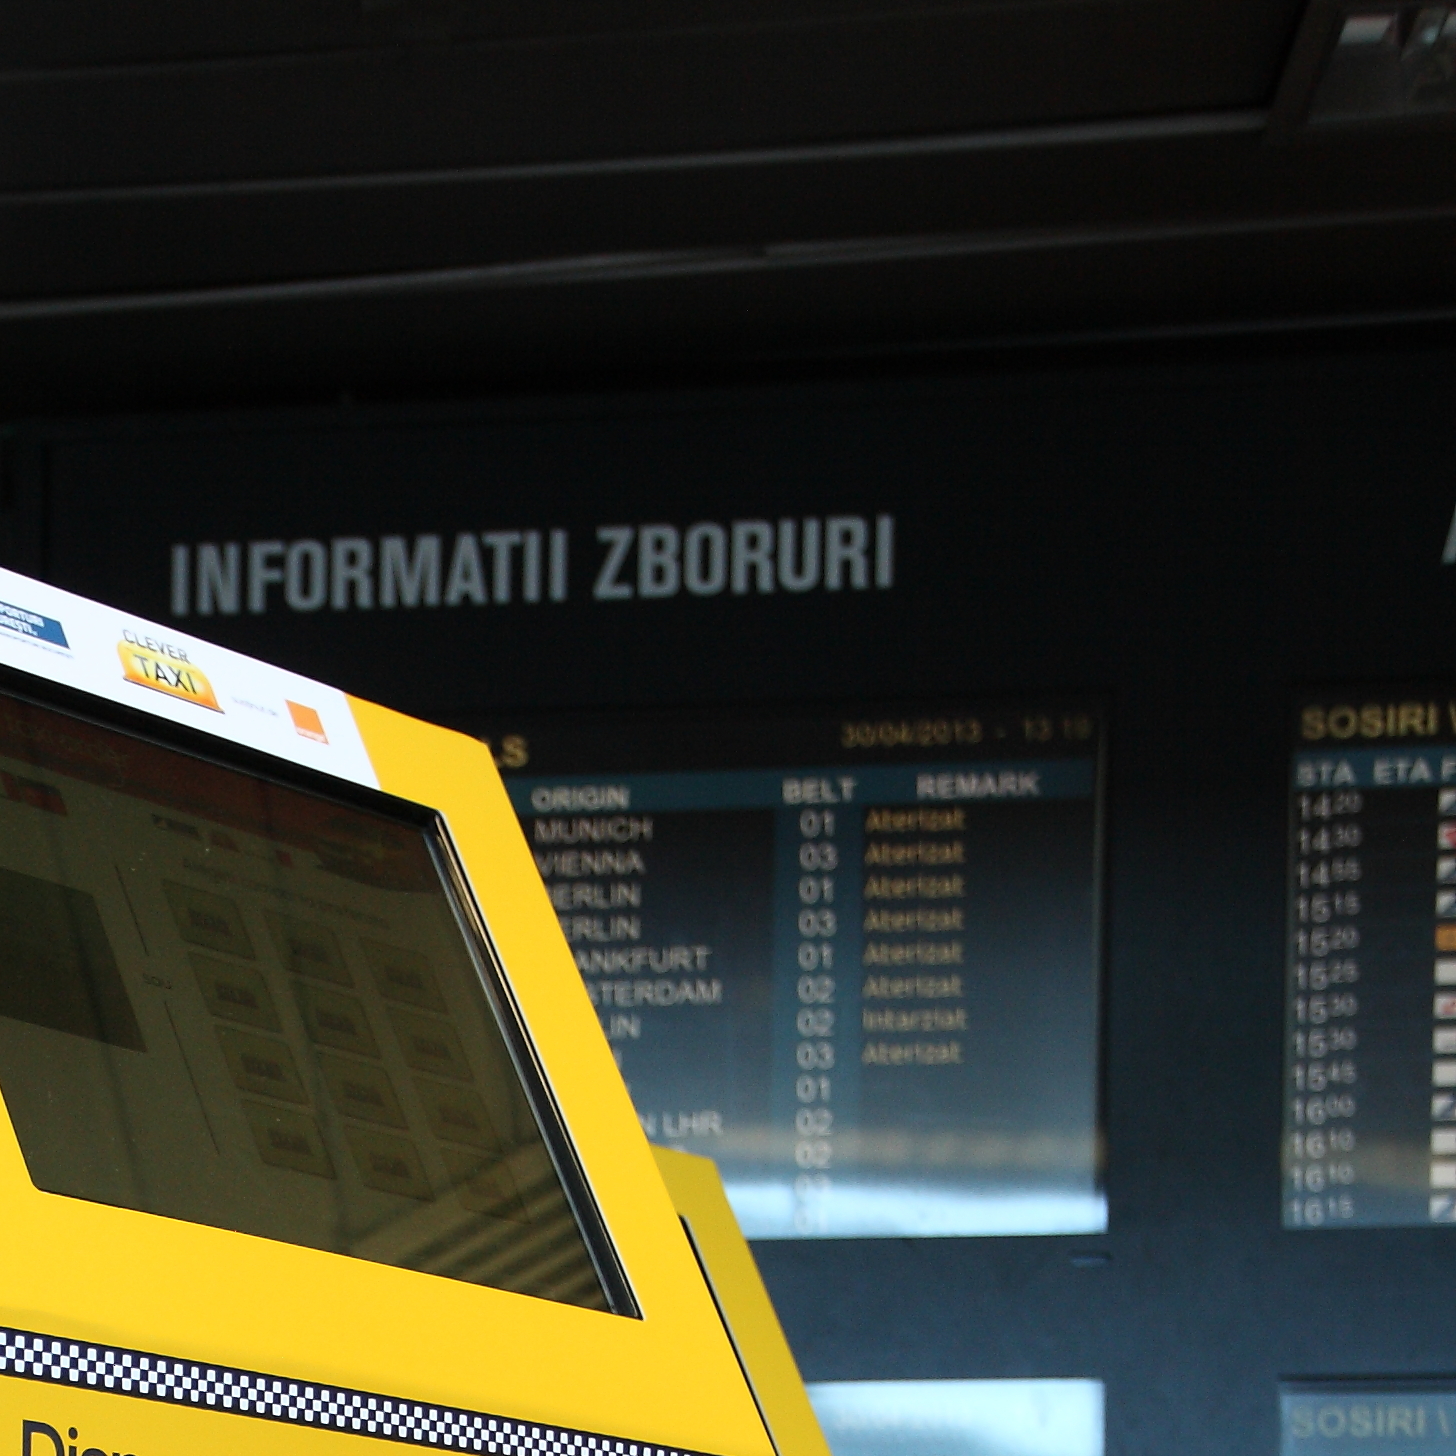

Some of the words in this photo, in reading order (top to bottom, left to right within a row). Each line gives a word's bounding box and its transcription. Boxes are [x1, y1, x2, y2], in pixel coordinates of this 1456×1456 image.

[171, 525, 566, 616] INFORMATII
[595, 513, 894, 602] ZBORURI
[122, 629, 191, 664] CLEVER
[133, 653, 197, 695] TAXI
[1302, 701, 1438, 741] SOSIRI
[1296, 759, 1356, 786] STA
[1373, 757, 1433, 785] ETA
[532, 786, 630, 812] ORIGIN
[783, 777, 857, 804] BELT
[917, 771, 1040, 800] REMARK
[535, 817, 653, 842] MUNICH
[801, 810, 835, 836] 01
[538, 850, 646, 876] VIENNA
[800, 844, 838, 871] 03
[799, 877, 834, 903] 01
[563, 916, 640, 942] ERLIN
[799, 910, 837, 937] 03
[578, 945, 711, 974] ANKFURT
[798, 943, 833, 970] 01
[797, 976, 835, 1003] 02
[796, 1009, 834, 1036] 02
[796, 1042, 834, 1069] 03
[796, 1075, 830, 1103] 01
[663, 1111, 723, 1137] LHR
[796, 1109, 833, 1136] 02
[1291, 1403, 1426, 1438] SOSIRI
